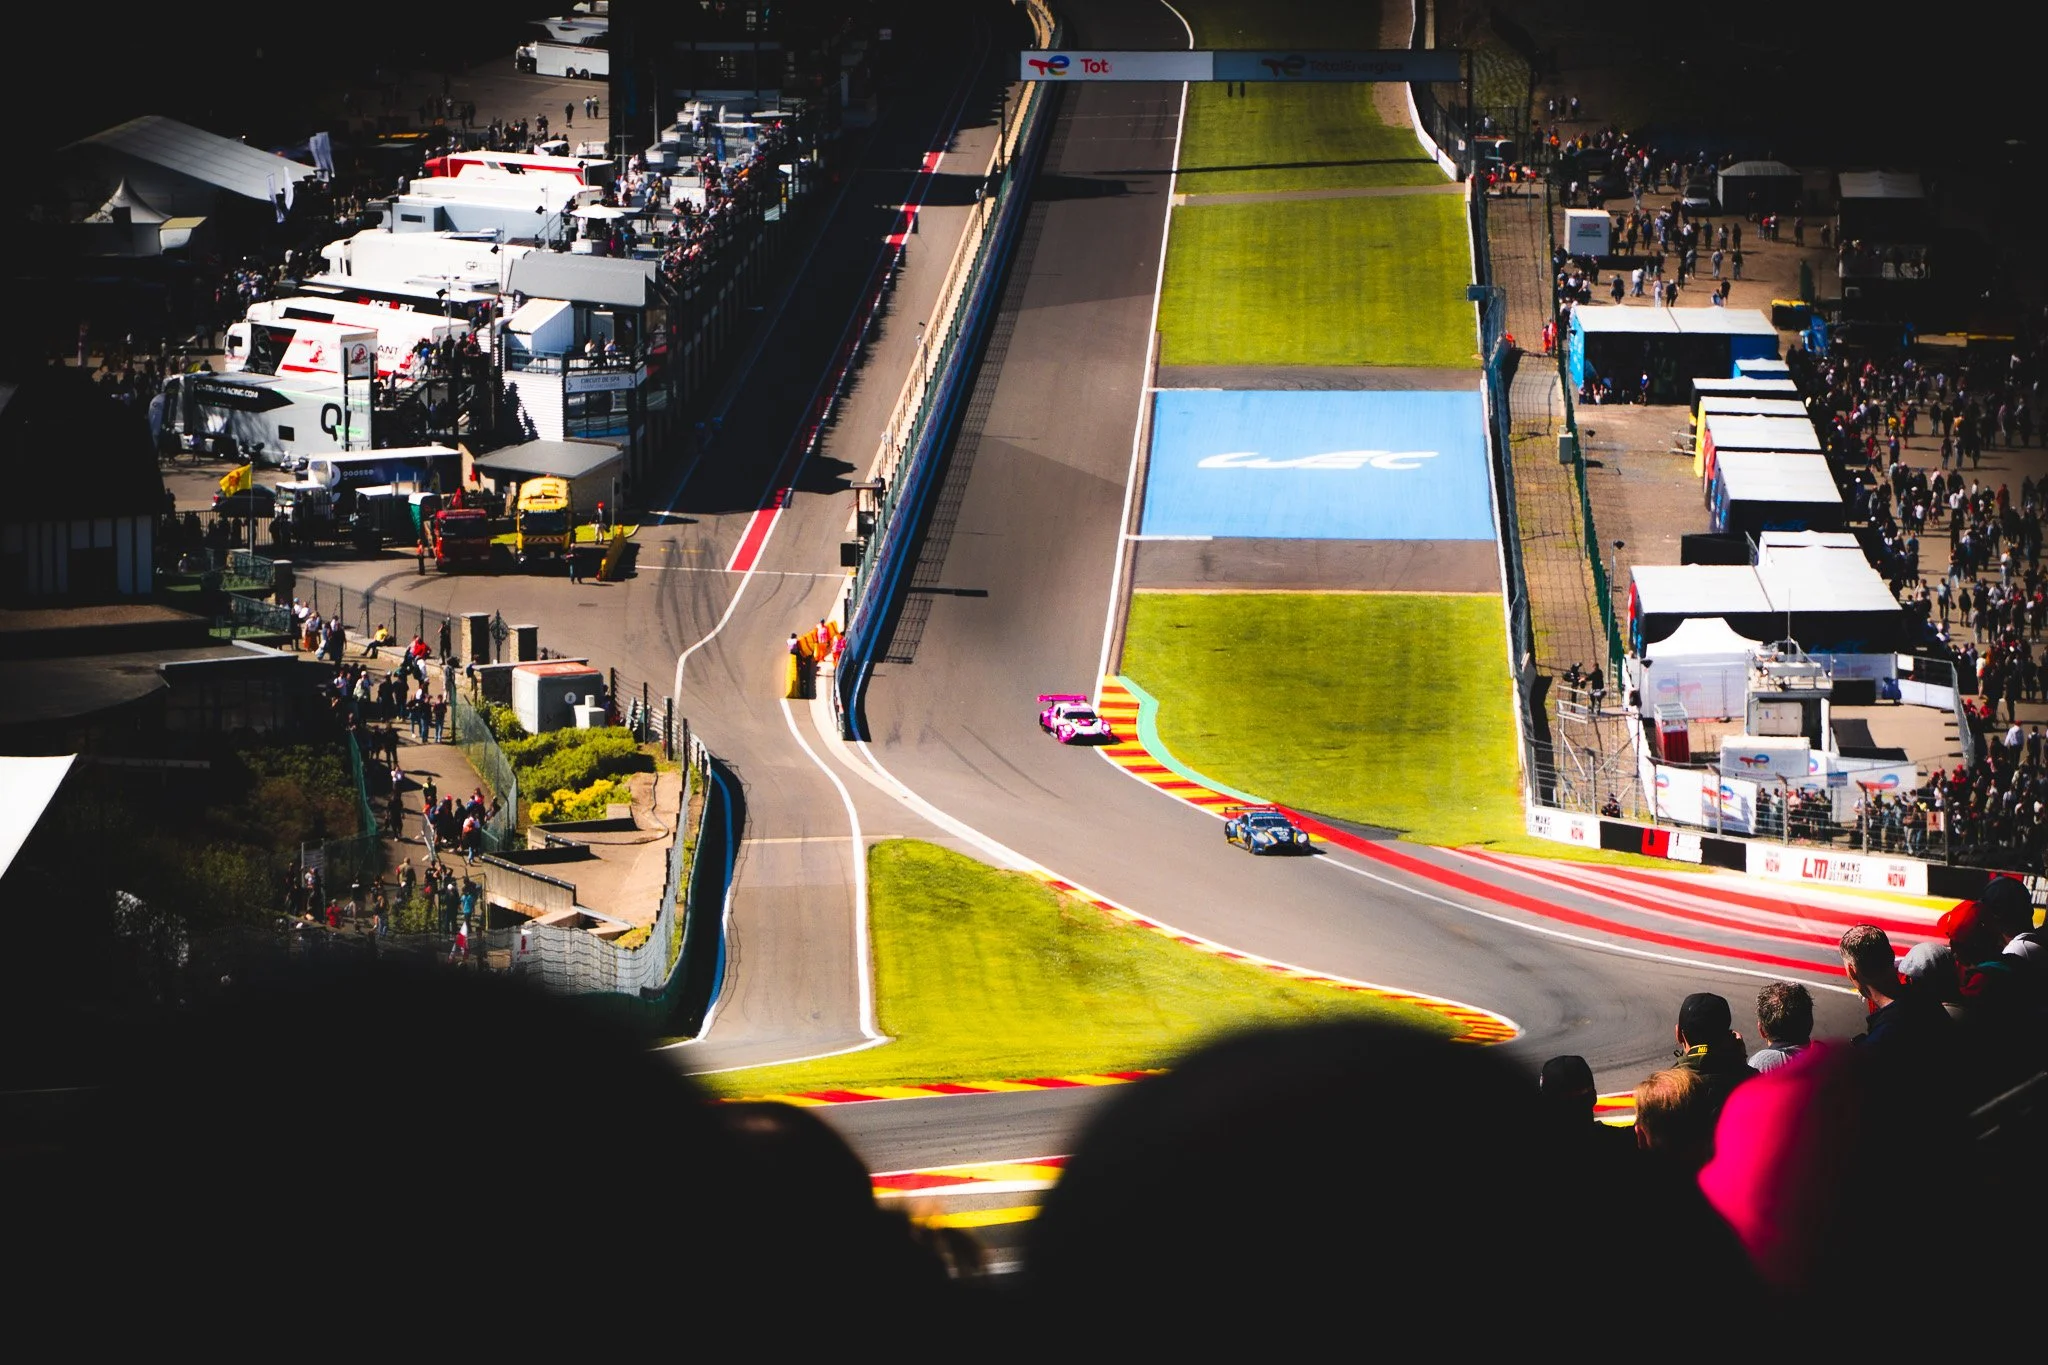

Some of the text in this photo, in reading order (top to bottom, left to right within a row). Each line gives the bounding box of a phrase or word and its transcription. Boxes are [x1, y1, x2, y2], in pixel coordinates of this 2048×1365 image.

[1309, 59, 1404, 75] TotalEnergies
[1765, 859, 1780, 873] NOW
[1840, 861, 1861, 873] MANS
[1828, 871, 1862, 884] ULTIMATE
[1887, 872, 1906, 888] NOW
